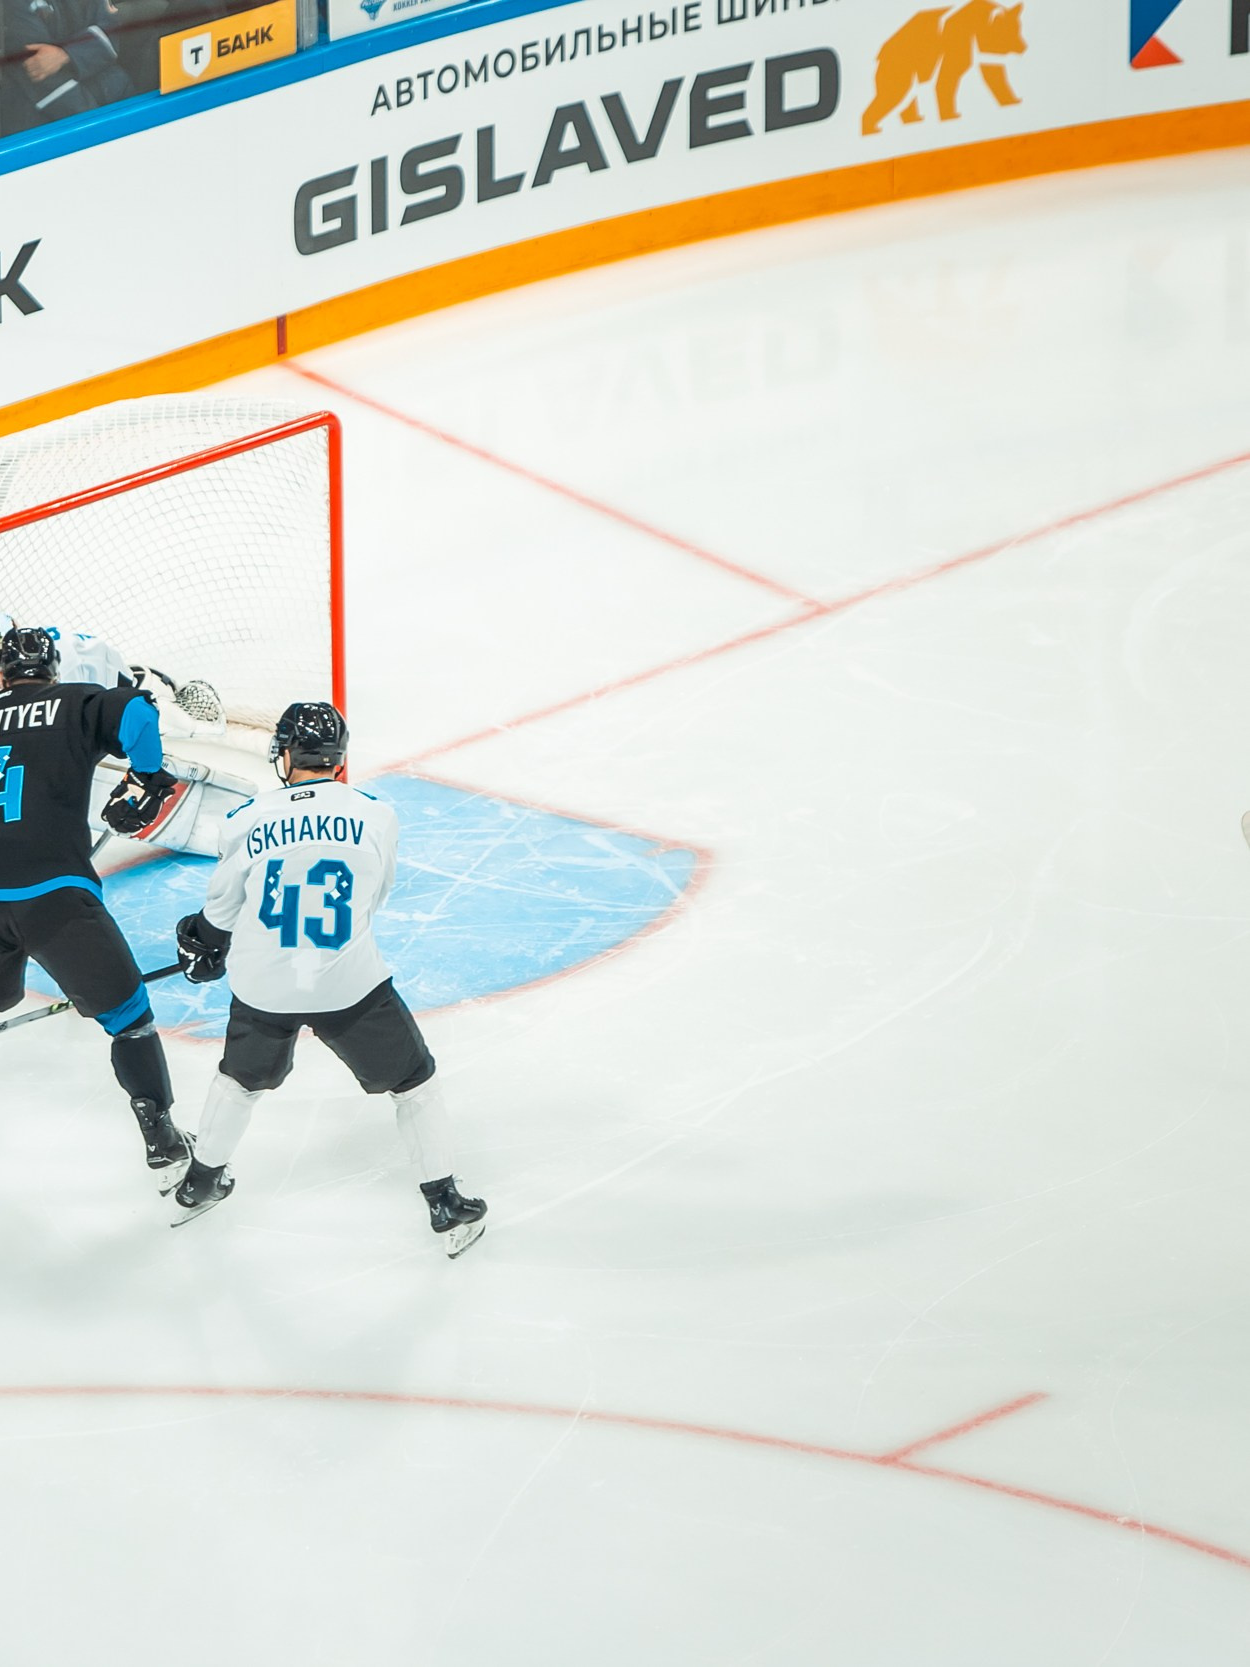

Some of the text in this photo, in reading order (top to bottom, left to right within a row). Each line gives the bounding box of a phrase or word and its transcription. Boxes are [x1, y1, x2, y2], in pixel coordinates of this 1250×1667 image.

[217, 24, 275, 59] БАНК
[370, 0, 842, 117] АВТОМОБИЛЬНЫЕ ШИ
[293, 46, 841, 257] GISLAVED
[246, 815, 364, 859] ISKHAKOV
[258, 858, 354, 951] 43
